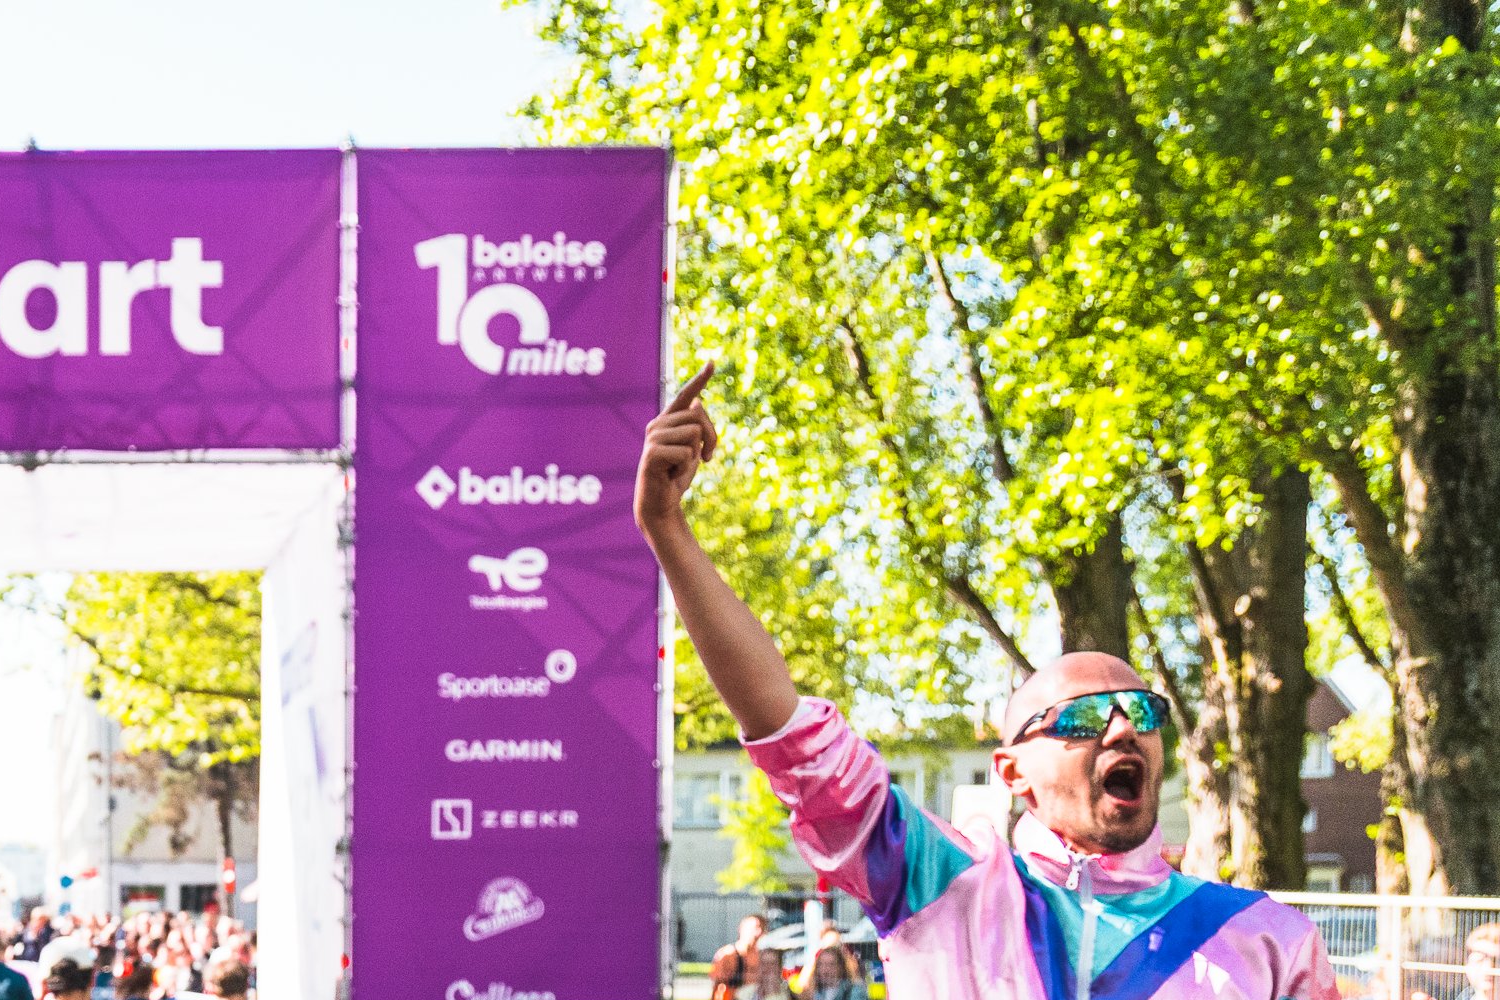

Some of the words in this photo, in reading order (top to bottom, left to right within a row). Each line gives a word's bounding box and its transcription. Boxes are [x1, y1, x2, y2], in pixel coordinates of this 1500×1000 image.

[472, 231, 607, 268] baloise
[414, 233, 550, 376] 10
[506, 338, 607, 376] miles
[458, 463, 602, 505] baloise
[444, 738, 563, 763] GARMIN
[481, 809, 580, 829] ZEEKR
